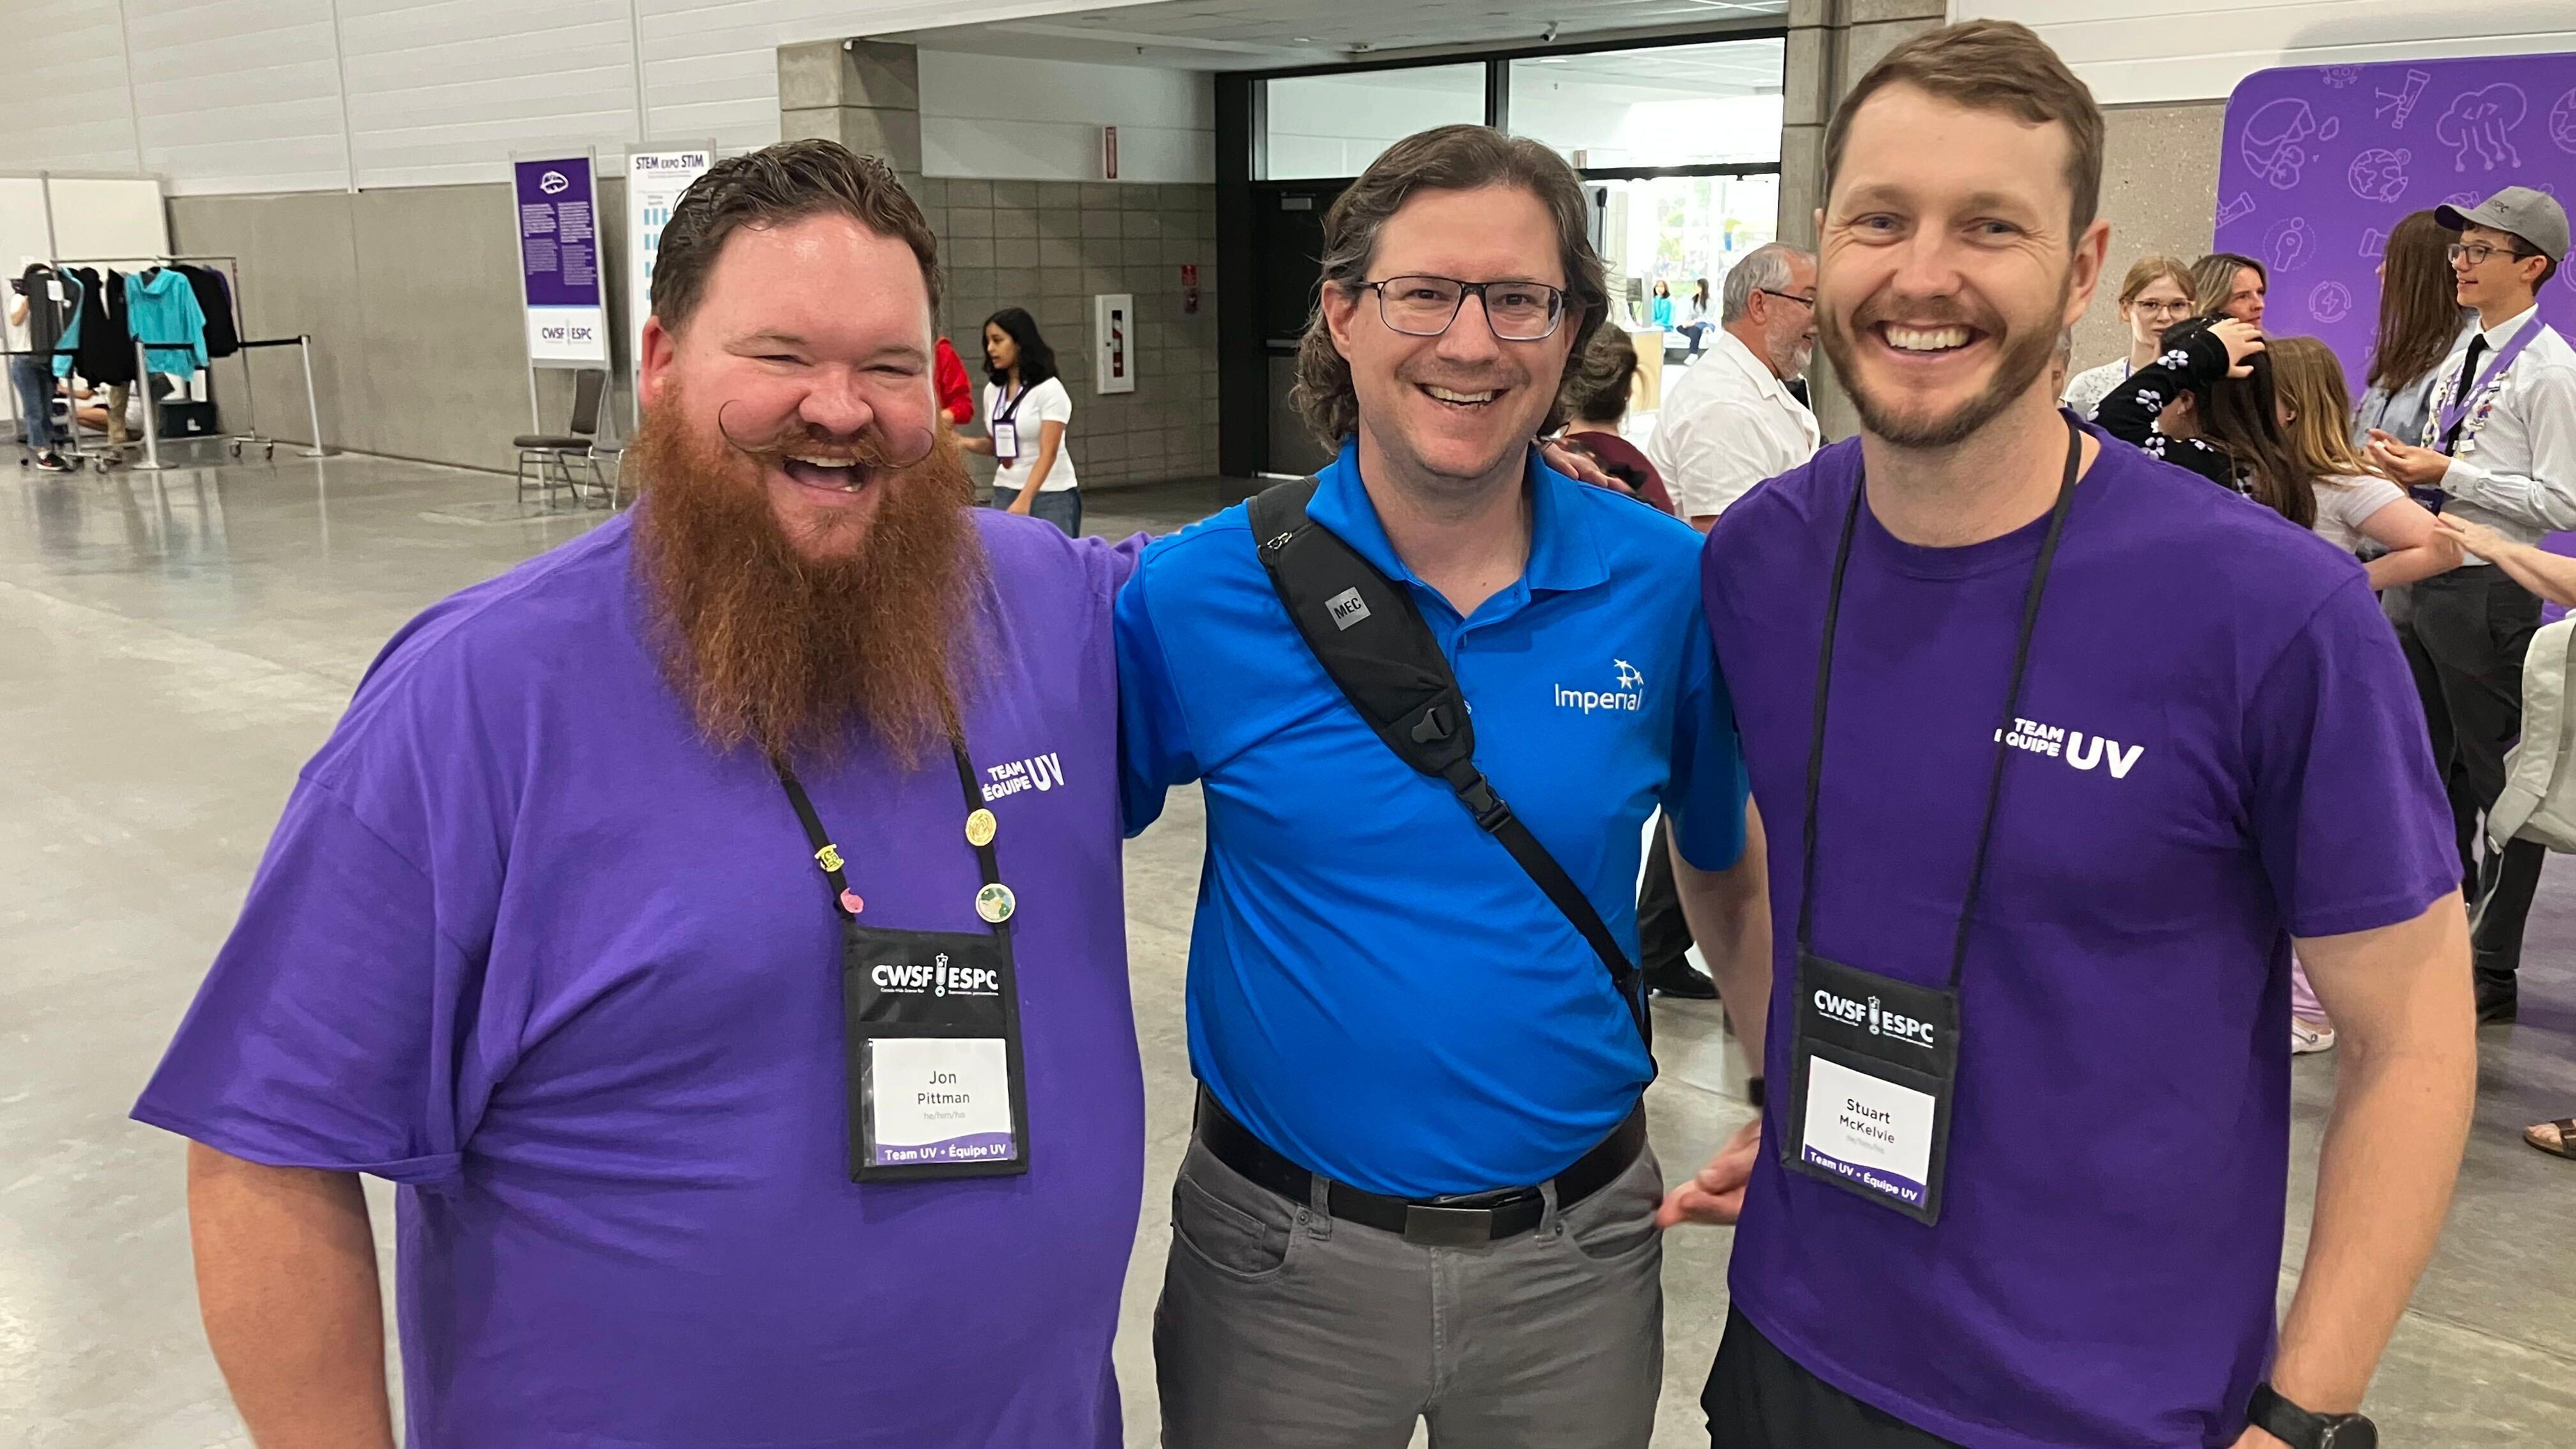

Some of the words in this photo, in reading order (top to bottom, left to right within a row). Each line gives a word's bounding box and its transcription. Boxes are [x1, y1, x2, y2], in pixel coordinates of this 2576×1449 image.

[636, 157, 659, 169] STEM
[661, 159, 678, 169] EXPO
[681, 154, 704, 168] STIM
[542, 327, 564, 339] CWSF
[572, 327, 592, 340] ESPC
[1334, 597, 1361, 619] MEC
[1554, 683, 1643, 714] Imperial
[2014, 717, 2065, 743] TEAM
[2066, 731, 2144, 779] UV
[987, 761, 1025, 781] TEAM
[1024, 752, 1064, 792] UV
[981, 775, 1032, 802] ÉQUIPE
[871, 964, 934, 986] CWSF
[948, 967, 999, 990] ESPC
[1814, 990, 1866, 1022] CWSF
[1882, 1011, 1934, 1043] ESPC
[929, 1071, 957, 1084] Jon
[917, 1092, 970, 1105] Pittman
[1846, 1098, 1890, 1124] Stuart
[1839, 1115, 1895, 1144] McKelvie
[885, 1149, 917, 1161] Team
[920, 1147, 937, 1158] UV
[949, 1144, 988, 1158] Équipe
[990, 1144, 1006, 1154] UV
[1810, 1151, 1837, 1170] Team
[1839, 1163, 1854, 1176] UV
[1864, 1172, 1899, 1195] Équipe
[1901, 1187, 1918, 1200] UV
